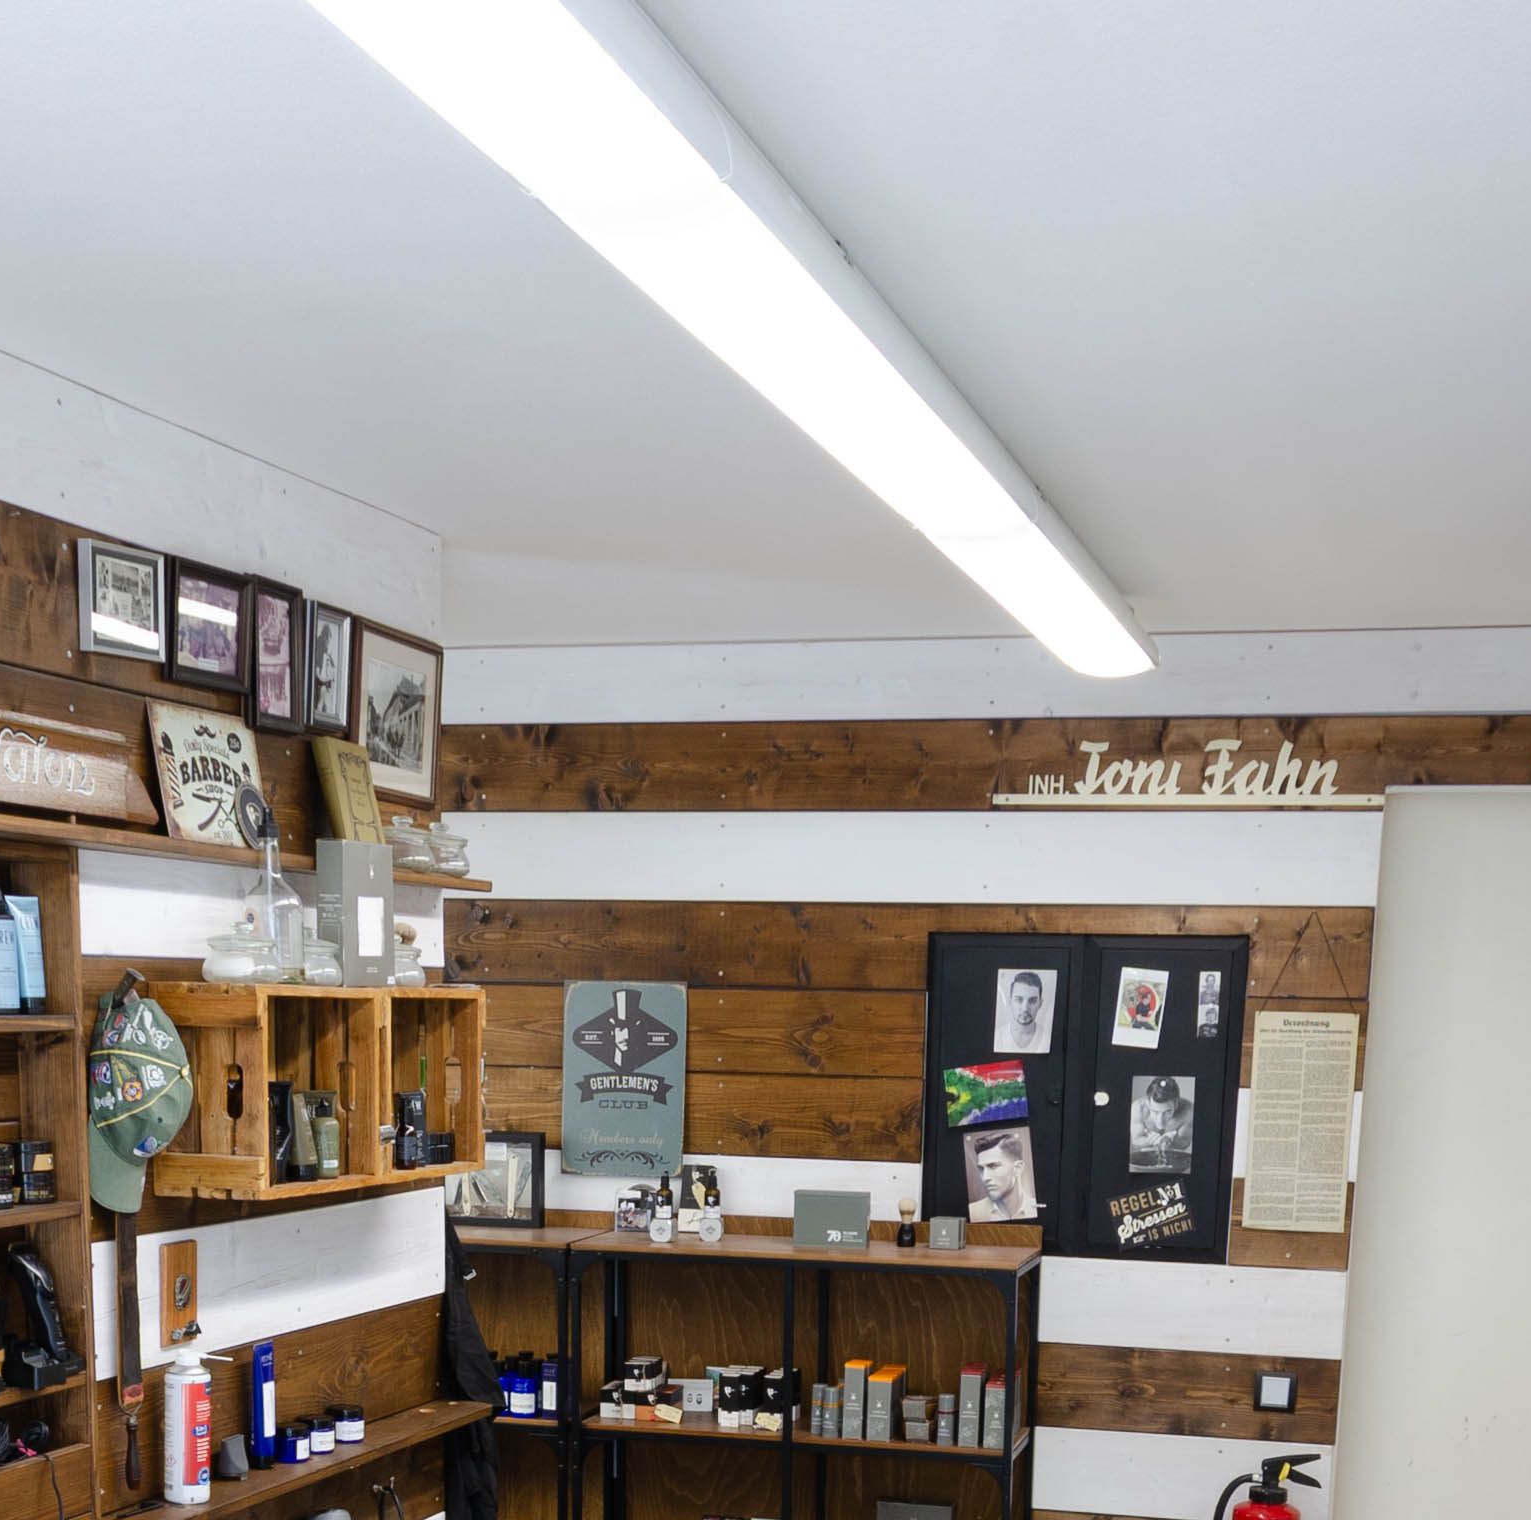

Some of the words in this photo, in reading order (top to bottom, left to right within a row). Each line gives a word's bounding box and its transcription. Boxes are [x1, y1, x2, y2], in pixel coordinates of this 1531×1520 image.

[180, 756, 242, 788] BARBER
[1028, 774, 1069, 796] INH.
[1202, 739, 1339, 796] Fahn
[205, 784, 225, 794] SHOP
[590, 1075, 659, 1092] GENTLEMEN'S
[598, 1100, 648, 1110] CLUB
[580, 1128, 635, 1146] Members
[638, 1132, 664, 1148] only
[1110, 1191, 1157, 1216] REGEL
[1118, 1202, 1187, 1244] Stressen
